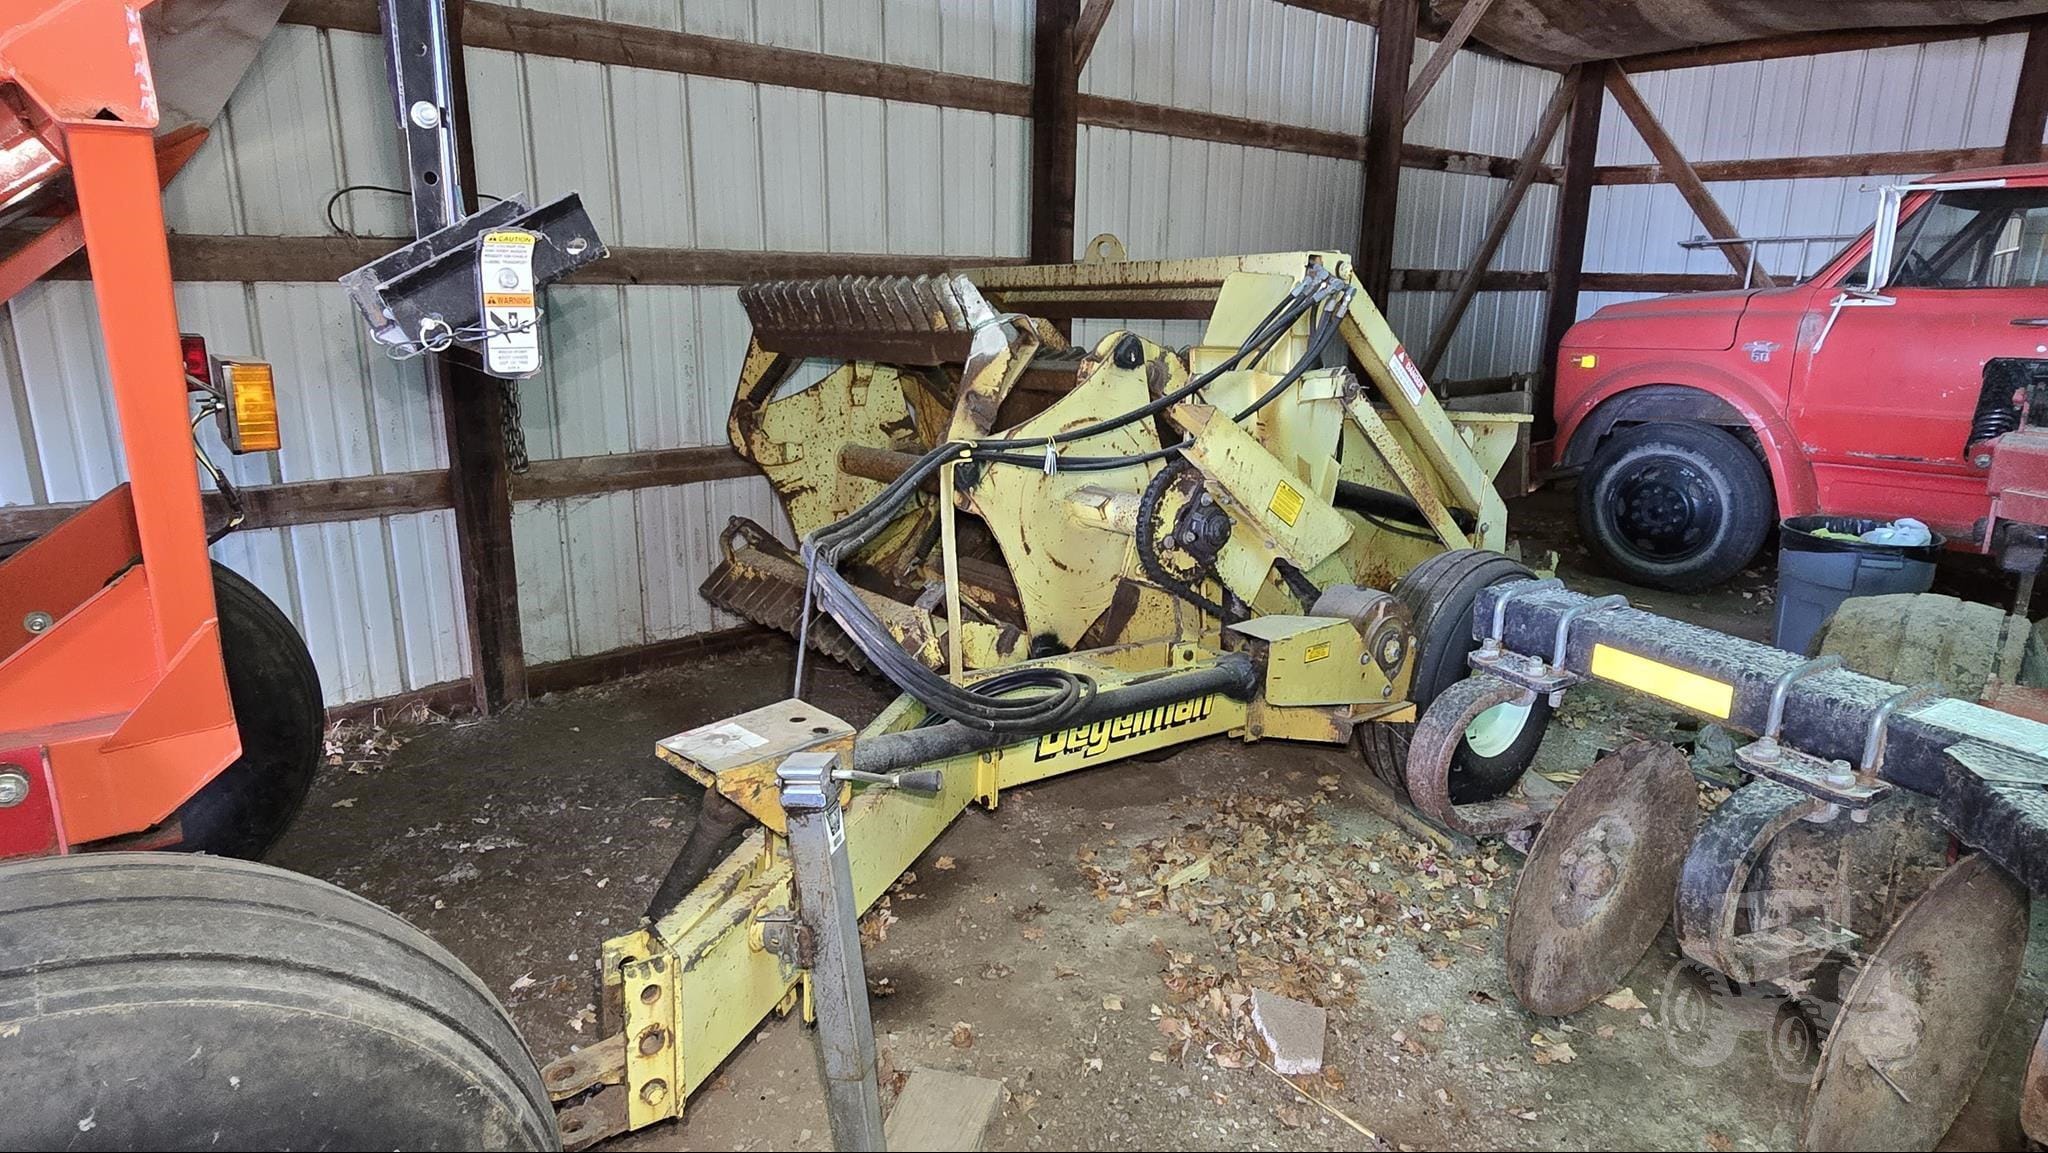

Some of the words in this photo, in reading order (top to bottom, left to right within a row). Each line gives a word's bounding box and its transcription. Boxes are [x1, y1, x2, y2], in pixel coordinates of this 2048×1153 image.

[498, 235, 532, 243] CAUTION
[497, 296, 531, 305] WARNING
[1405, 361, 1424, 390] DANGER
